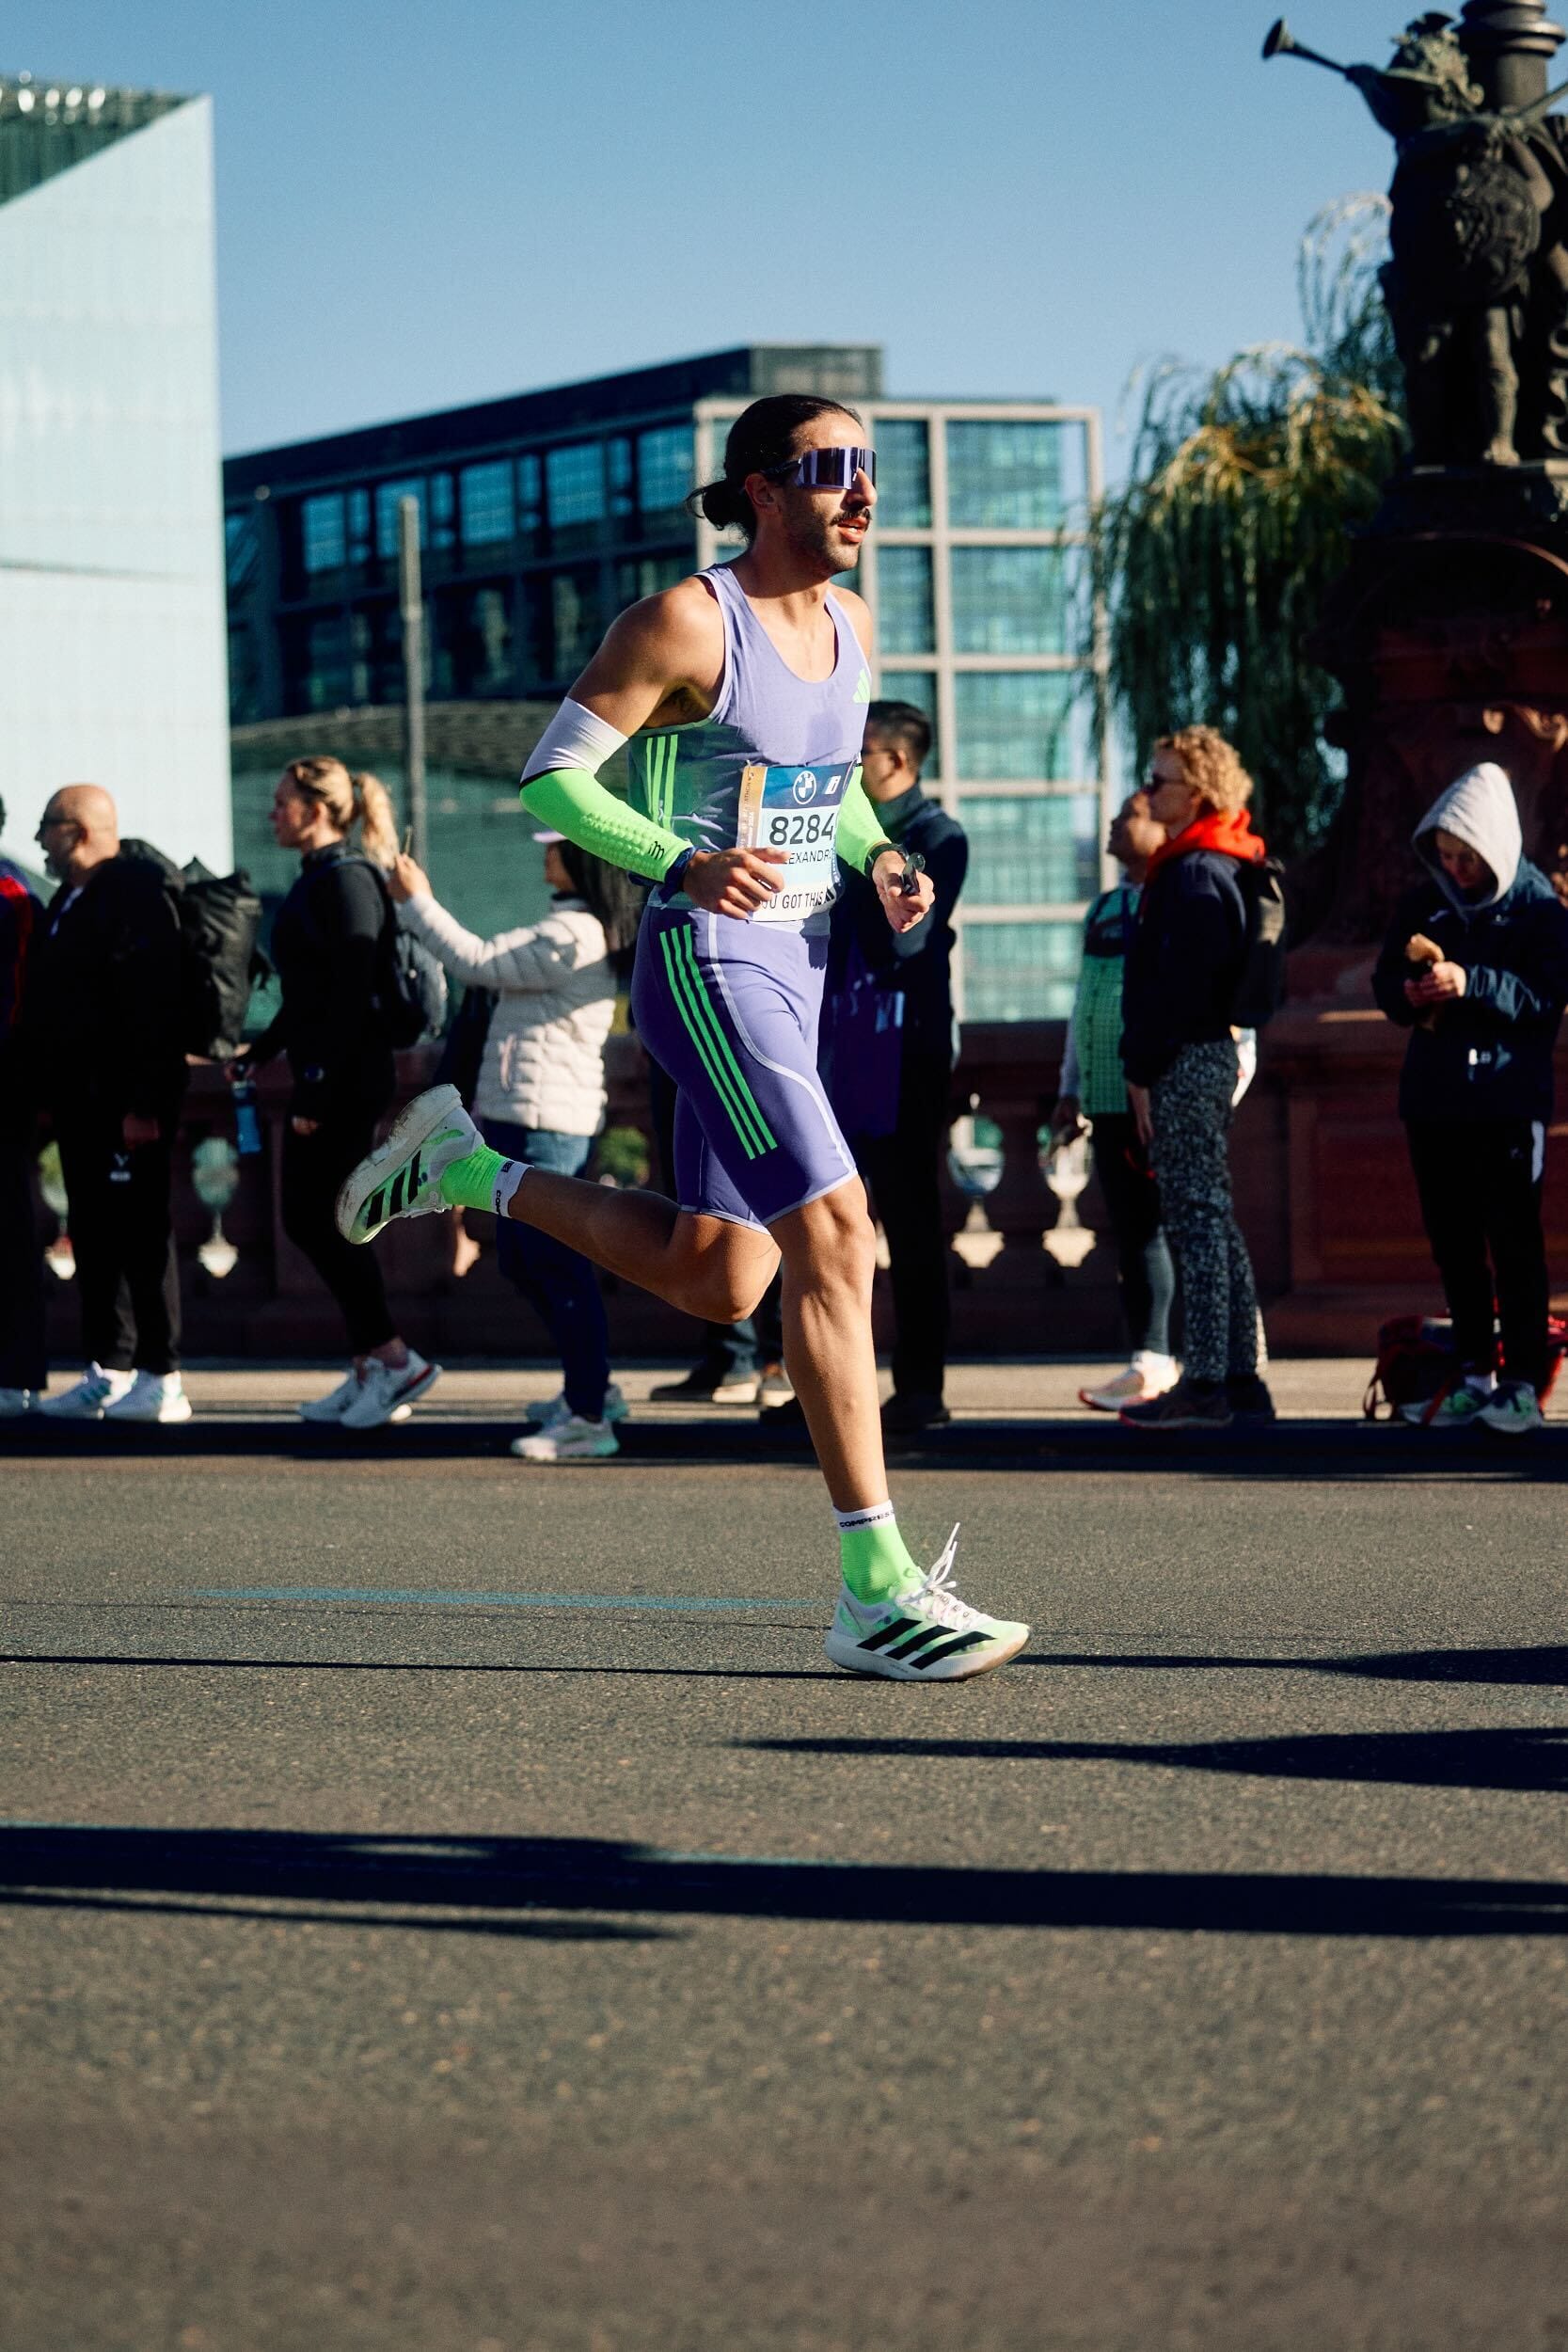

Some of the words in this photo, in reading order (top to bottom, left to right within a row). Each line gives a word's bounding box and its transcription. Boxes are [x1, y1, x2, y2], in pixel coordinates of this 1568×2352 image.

[768, 812, 834, 846] 8284
[783, 849, 832, 865] EXANDR
[782, 894, 803, 910] GOT
[805, 891, 824, 907] THIS
